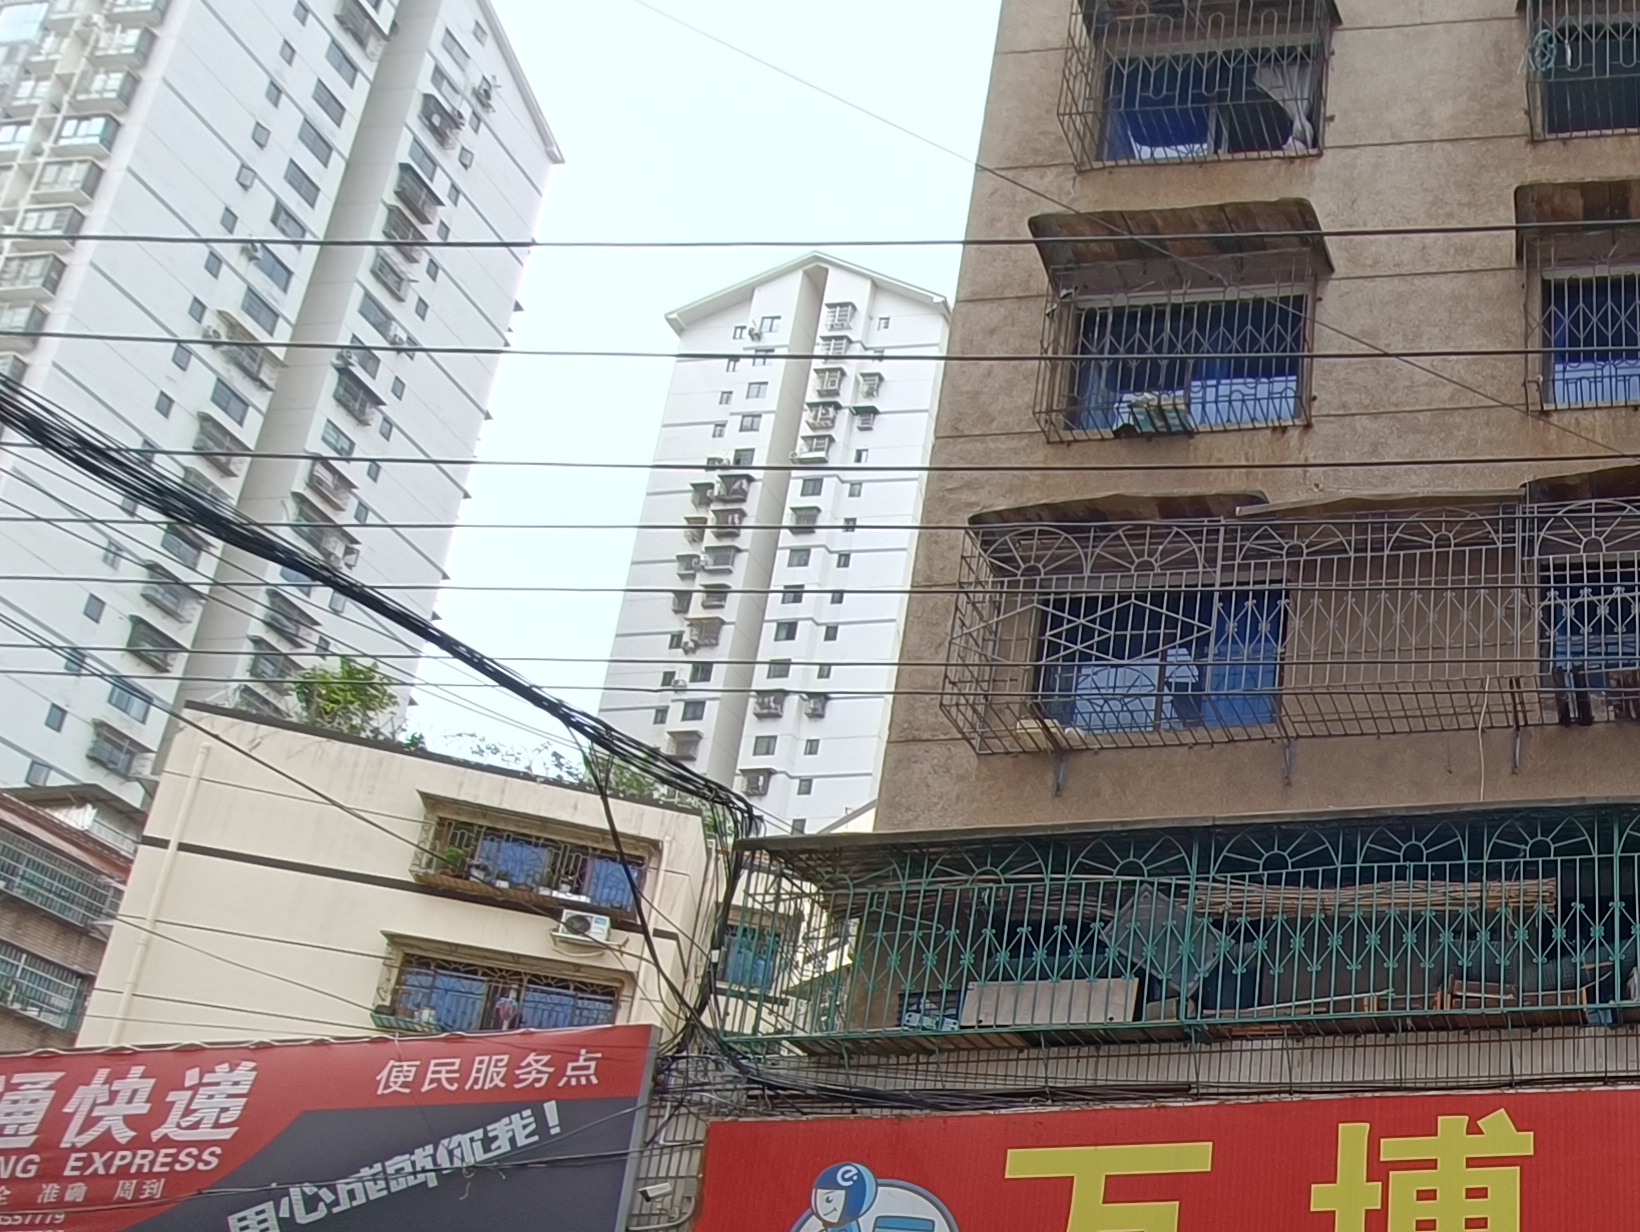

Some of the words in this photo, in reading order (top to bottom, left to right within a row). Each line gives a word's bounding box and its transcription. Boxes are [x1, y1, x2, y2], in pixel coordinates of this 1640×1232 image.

[375, 1048, 602, 1095] 便民服务点
[63, 1147, 222, 1177] EXPRESS
[114, 1177, 165, 1202] 周到
